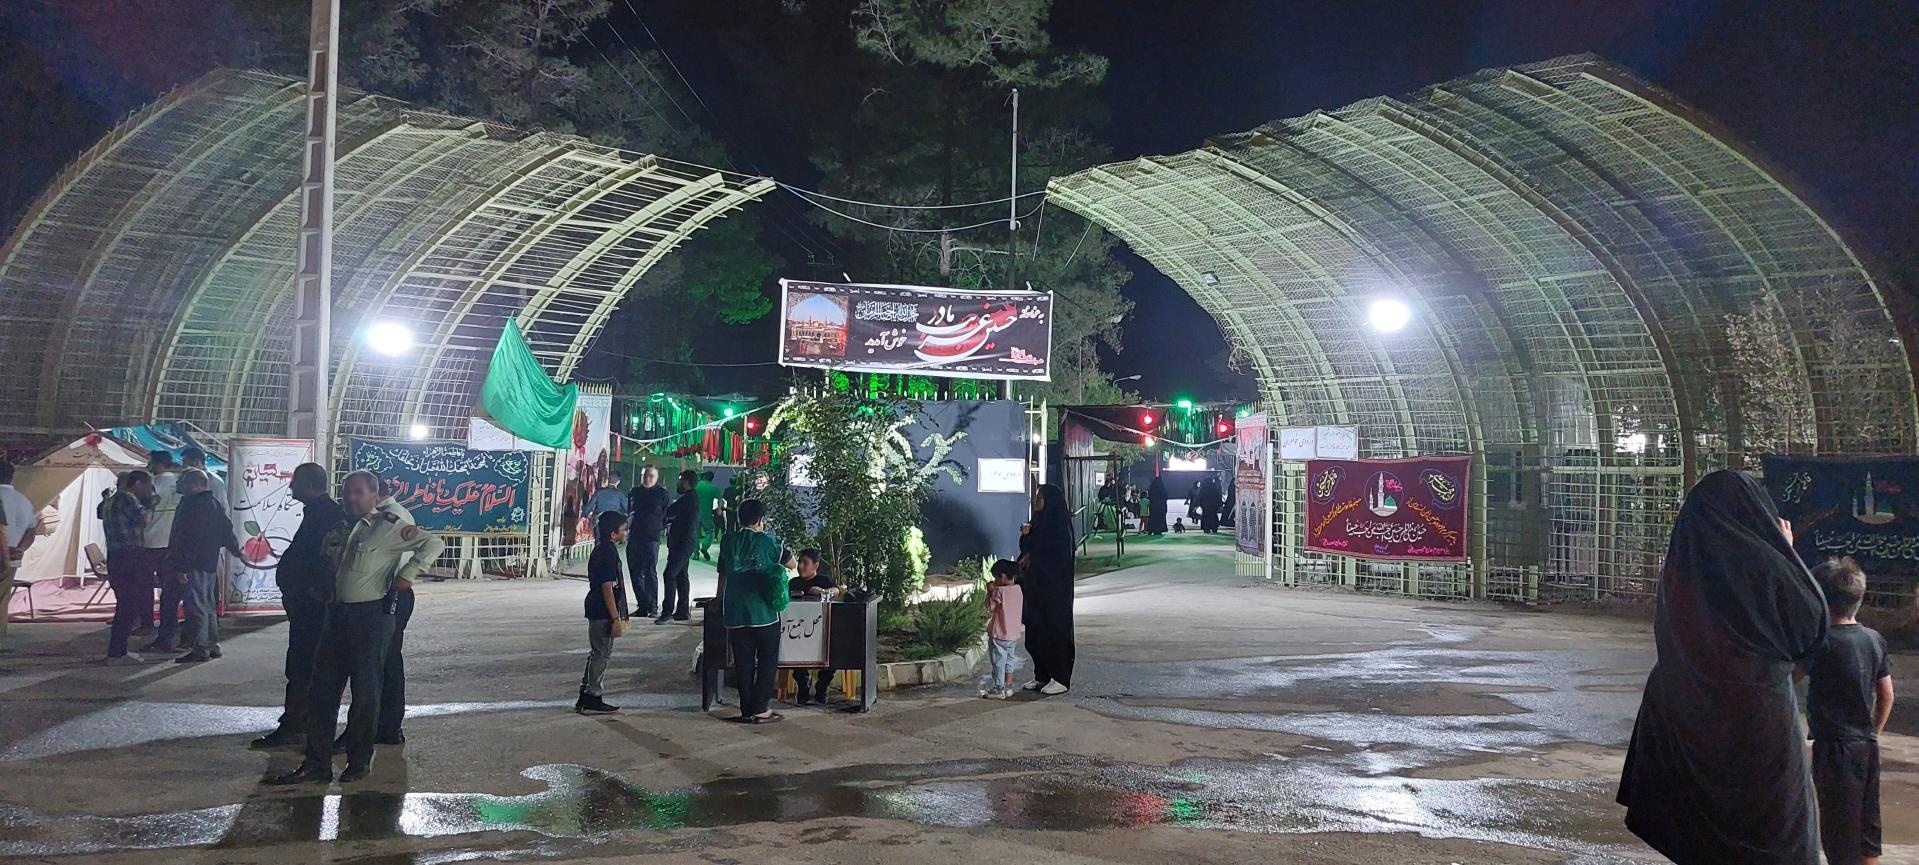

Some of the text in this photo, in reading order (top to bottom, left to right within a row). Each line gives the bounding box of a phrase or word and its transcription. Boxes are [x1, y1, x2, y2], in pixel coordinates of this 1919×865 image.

[927, 304, 955, 325] مادر
[863, 327, 908, 354] خوش آمدید
[913, 314, 1018, 364] حسین
[233, 498, 277, 511] سلامت
[453, 480, 480, 515] علیک
[479, 483, 516, 516] السلام
[788, 619, 804, 640] جمع
[803, 614, 822, 638] محل
